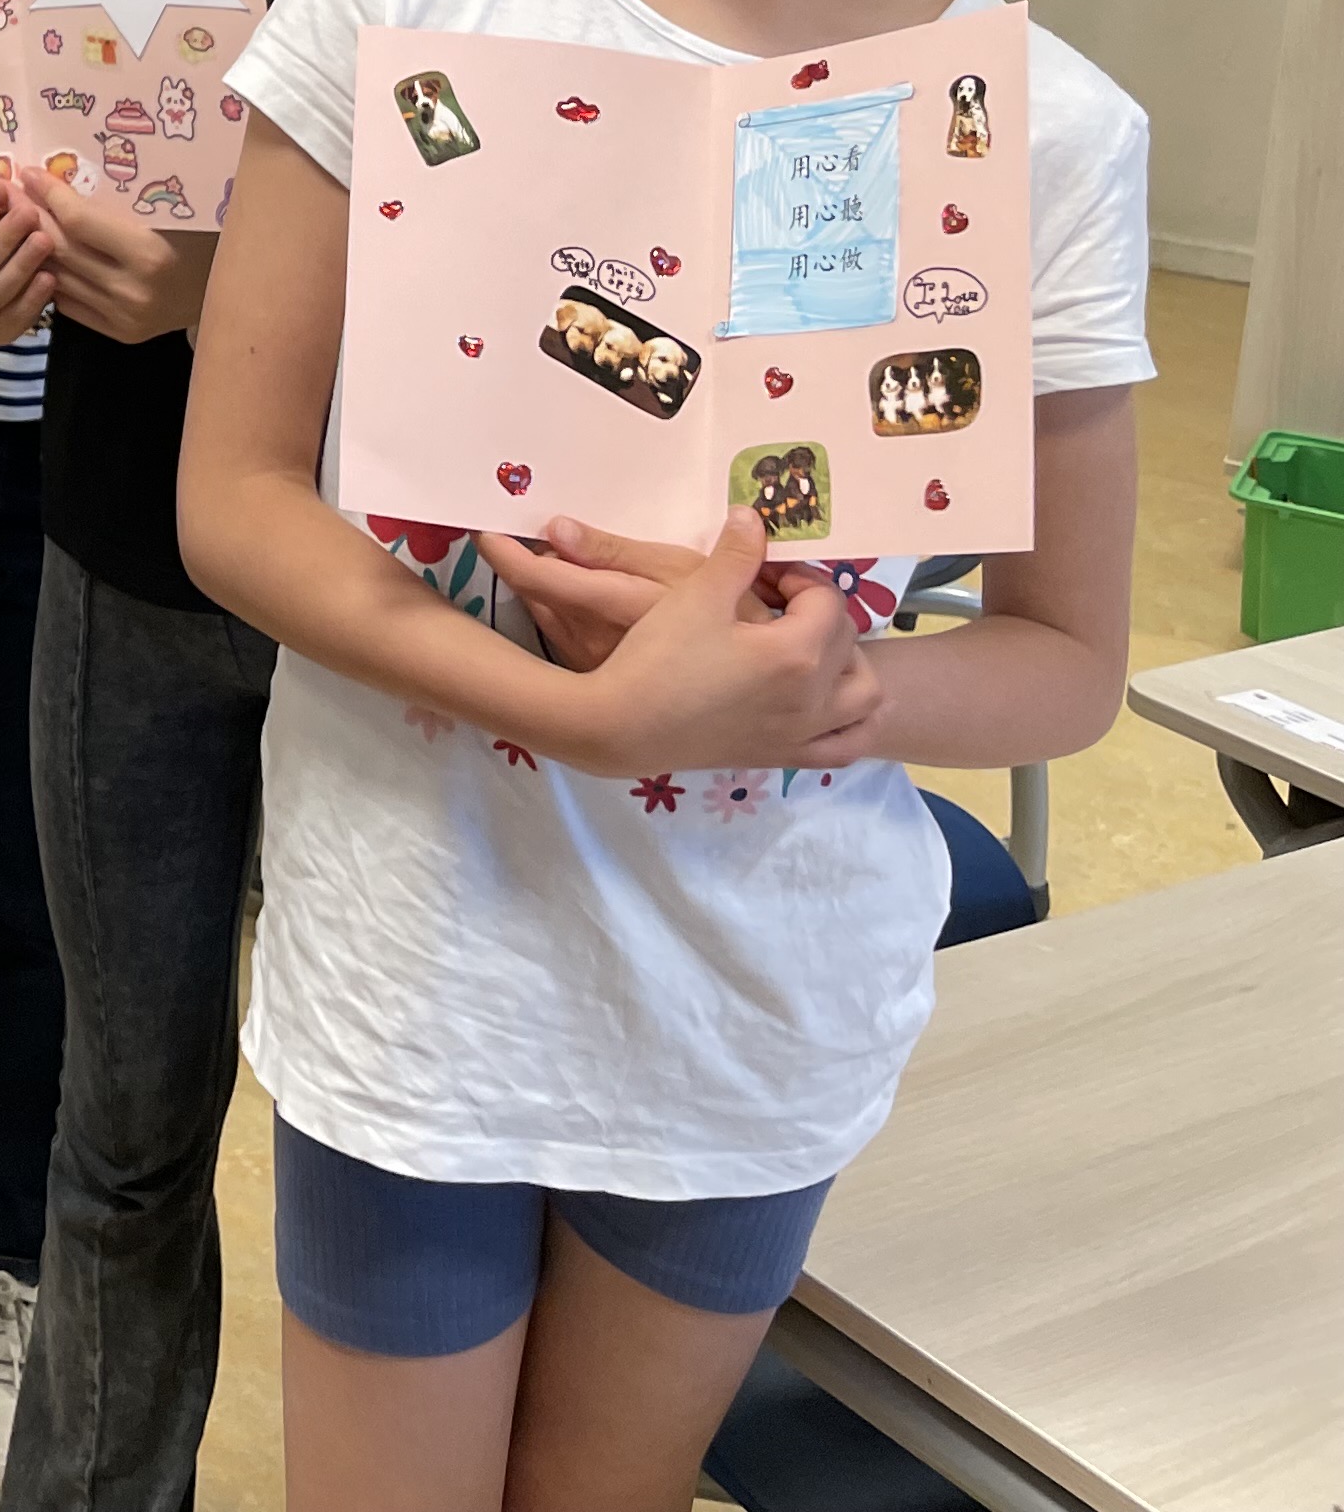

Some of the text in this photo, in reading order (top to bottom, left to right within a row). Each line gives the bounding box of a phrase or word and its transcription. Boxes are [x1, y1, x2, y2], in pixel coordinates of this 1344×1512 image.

[40, 86, 96, 117] Today
[791, 143, 862, 181] 用心看
[789, 193, 864, 231] 用心聽
[787, 245, 864, 281] 用心做
